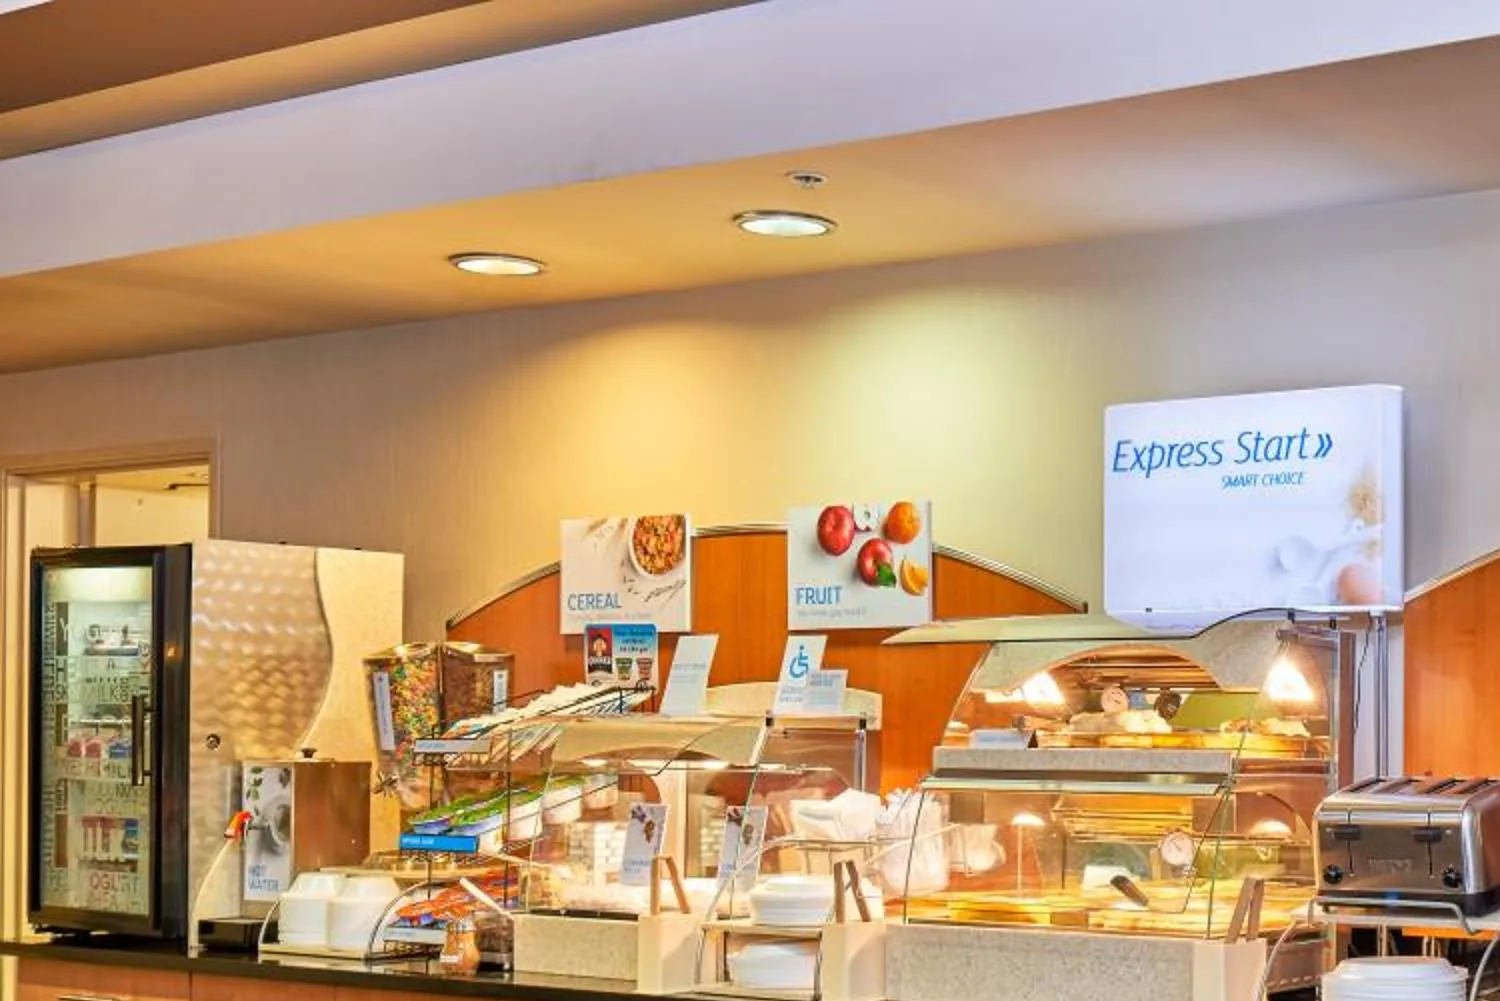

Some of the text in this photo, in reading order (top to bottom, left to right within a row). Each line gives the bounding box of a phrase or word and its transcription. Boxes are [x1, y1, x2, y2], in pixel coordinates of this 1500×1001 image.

[1112, 439, 1225, 479] Express
[1221, 471, 1305, 490] SMART CHOICE
[567, 593, 623, 611] CEREAL
[794, 586, 842, 605] FRUIT
